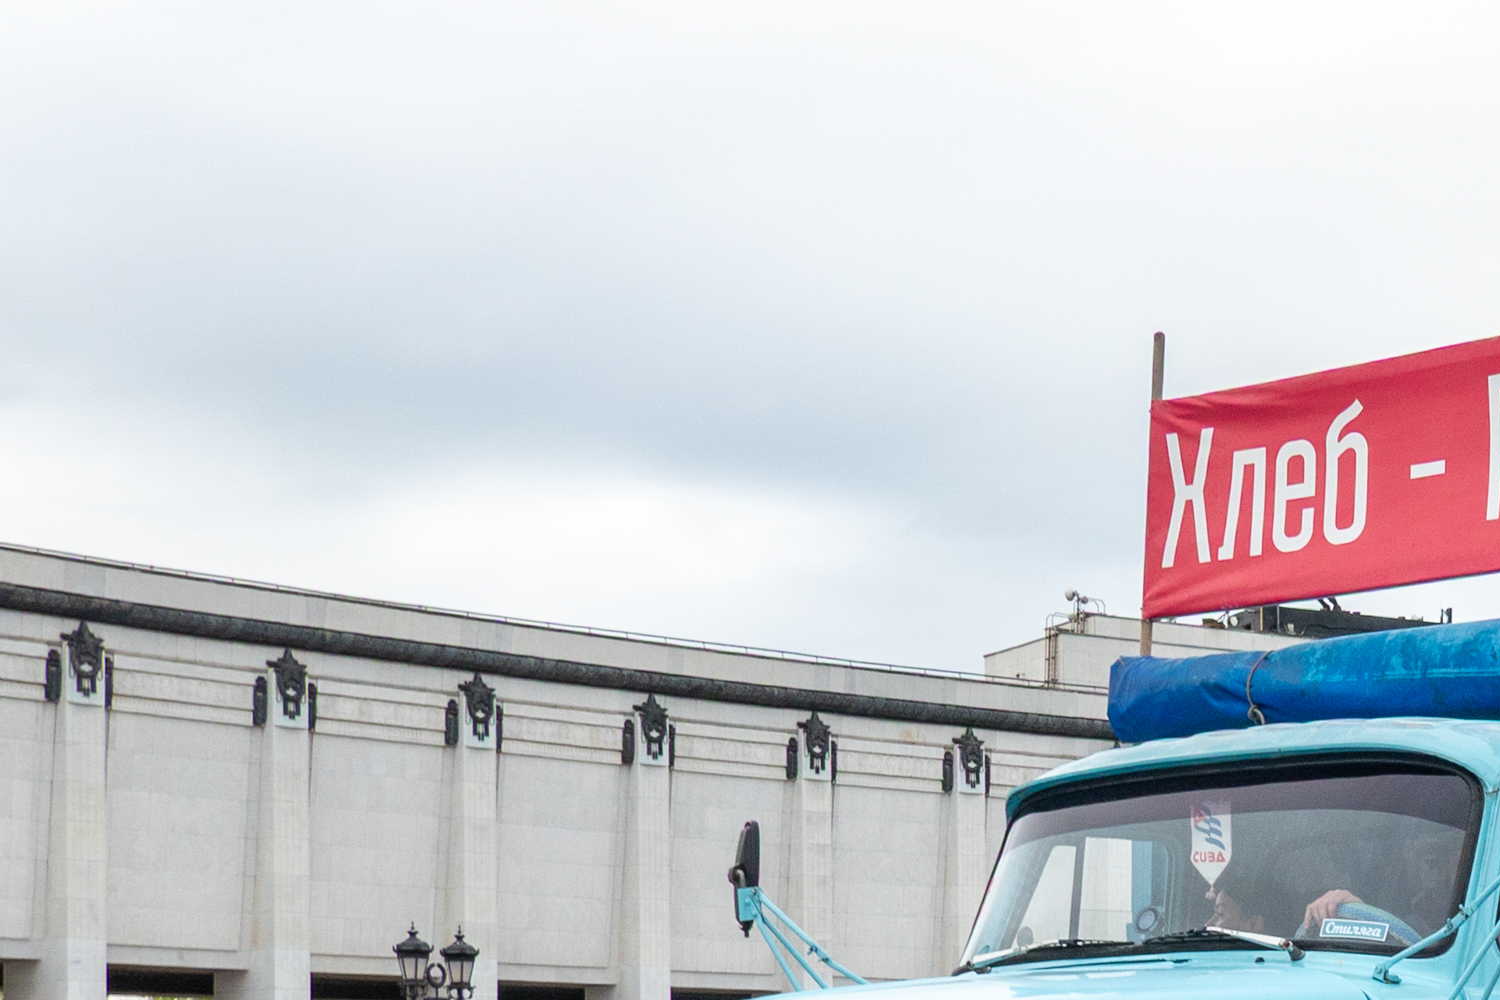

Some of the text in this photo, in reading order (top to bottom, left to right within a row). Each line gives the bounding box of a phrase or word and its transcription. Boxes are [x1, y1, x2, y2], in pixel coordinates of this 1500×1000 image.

[1161, 399, 1369, 568] Хлеб
[1192, 851, 1226, 863] CUBA
[1325, 921, 1382, 937] Стиляга
